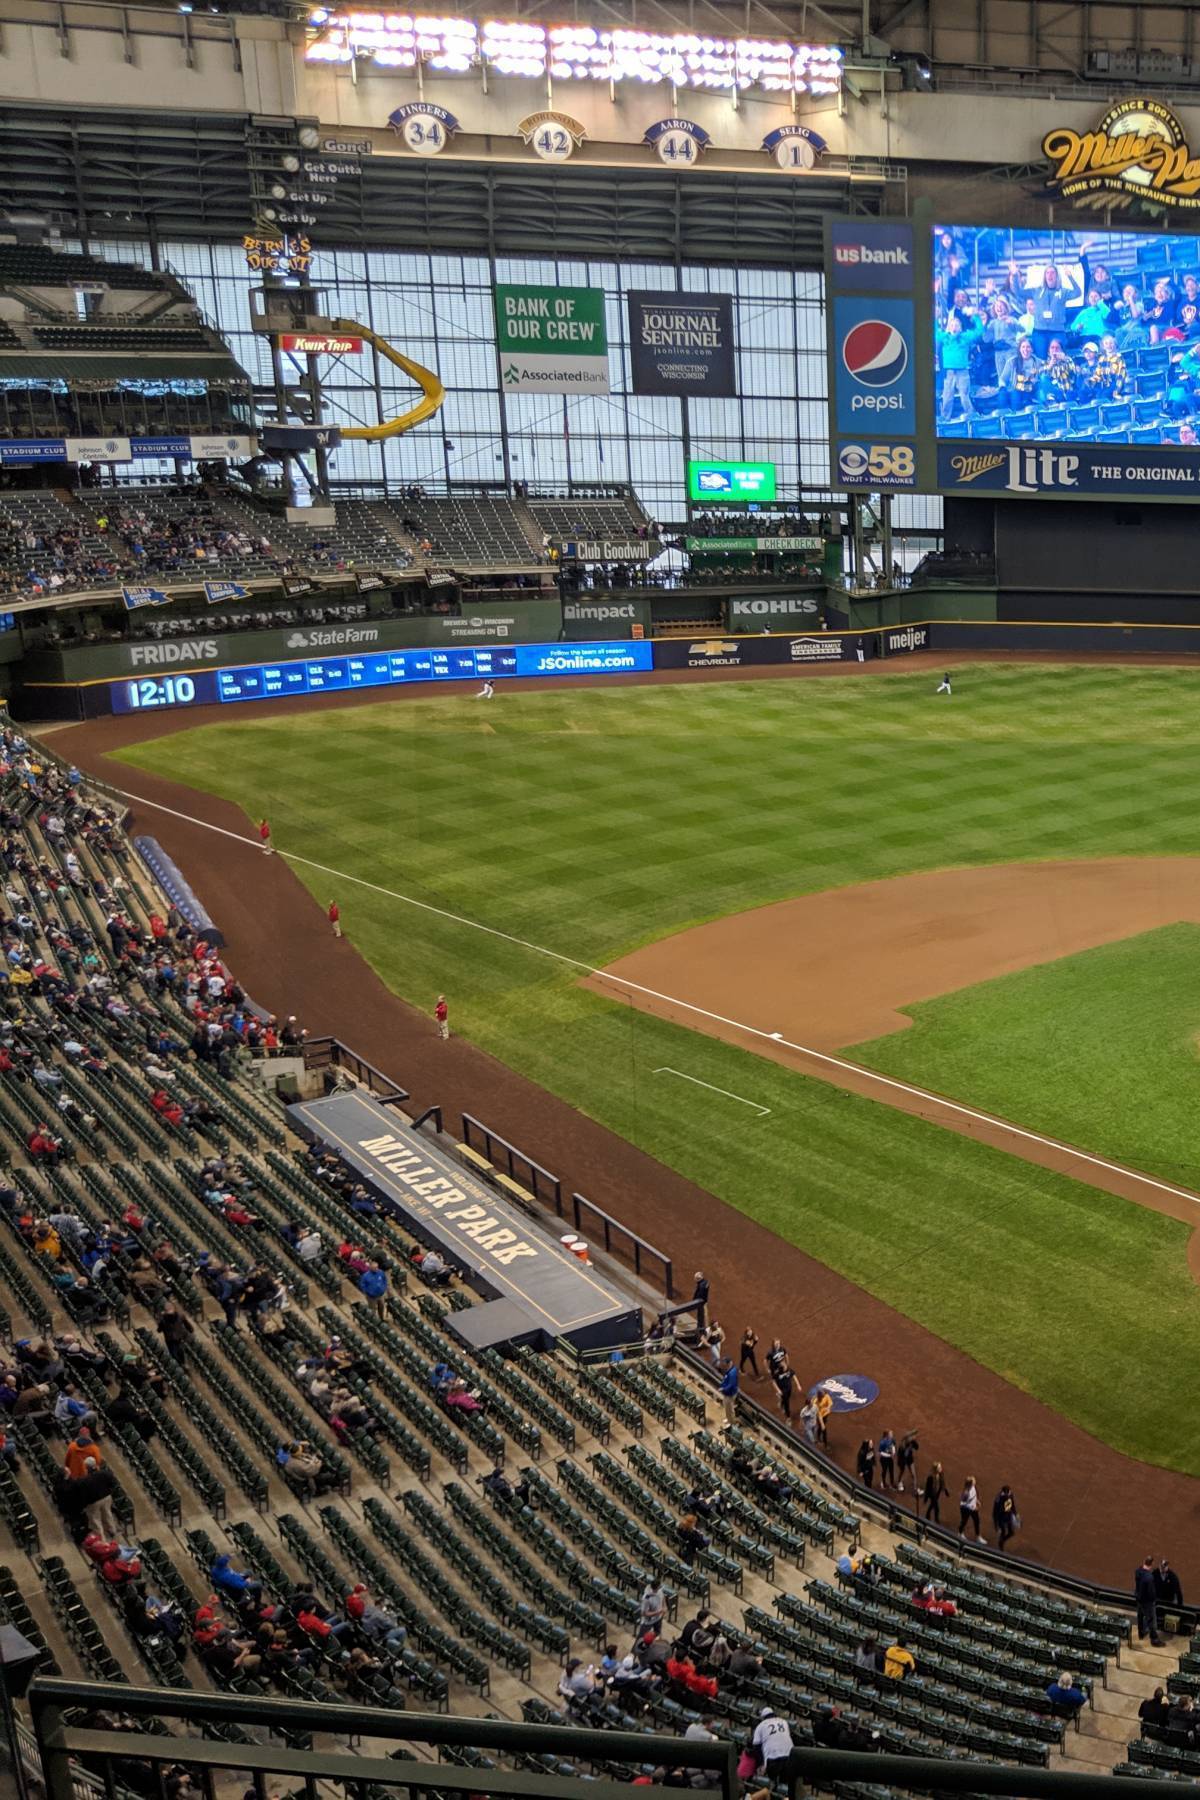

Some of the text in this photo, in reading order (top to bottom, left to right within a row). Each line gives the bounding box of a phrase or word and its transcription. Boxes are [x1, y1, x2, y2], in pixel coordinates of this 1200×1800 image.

[400, 104, 448, 120] FINGERS
[1111, 101, 1170, 122] SINCE 2001
[410, 122, 441, 146] 34
[660, 120, 694, 132] AARON
[779, 127, 810, 138] SELIG
[324, 140, 372, 152] Gone!
[538, 130, 568, 154] 42
[664, 138, 694, 160] 44
[790, 146, 802, 168] 1
[1044, 128, 1165, 179] Miller
[304, 162, 362, 175] Get Outta
[309, 174, 338, 184] Here
[290, 192, 327, 204] Get Up
[1063, 180, 1088, 197] HOME
[1090, 178, 1102, 189] OF
[1104, 178, 1122, 190] THE
[1125, 182, 1177, 206] MILWAUKEE
[279, 214, 316, 225] Get Up
[505, 297, 575, 318] BANK OF
[507, 319, 541, 340] OUR
[642, 315, 722, 332] JOURNAL
[642, 330, 722, 348] SENTINEL
[658, 364, 708, 373] CONNECTING
[662, 372, 706, 380] WISCONSIN
[852, 393, 904, 412] pepsi
[133, 444, 190, 453] STADIUM CLUB
[867, 446, 915, 477] 58
[951, 446, 1080, 493] Miller Lite
[870, 476, 914, 485] MILWAUKEE
[1092, 466, 1122, 480] THE
[1125, 466, 1195, 482] ORIGINAL
[578, 541, 650, 560] Club Goodwill
[764, 538, 792, 549] CHECK
[796, 538, 817, 550] DECK
[575, 602, 636, 621] impact
[732, 600, 818, 614] KOHL'S
[889, 629, 927, 651] meijer
[131, 640, 218, 666] FRIDAYS
[538, 656, 635, 671] JSOnline.com
[688, 658, 742, 667] CHEVROLET
[130, 677, 195, 708] 12:10
[358, 1134, 538, 1266] MILLER PARK
[768, 1723, 786, 1736] 28
